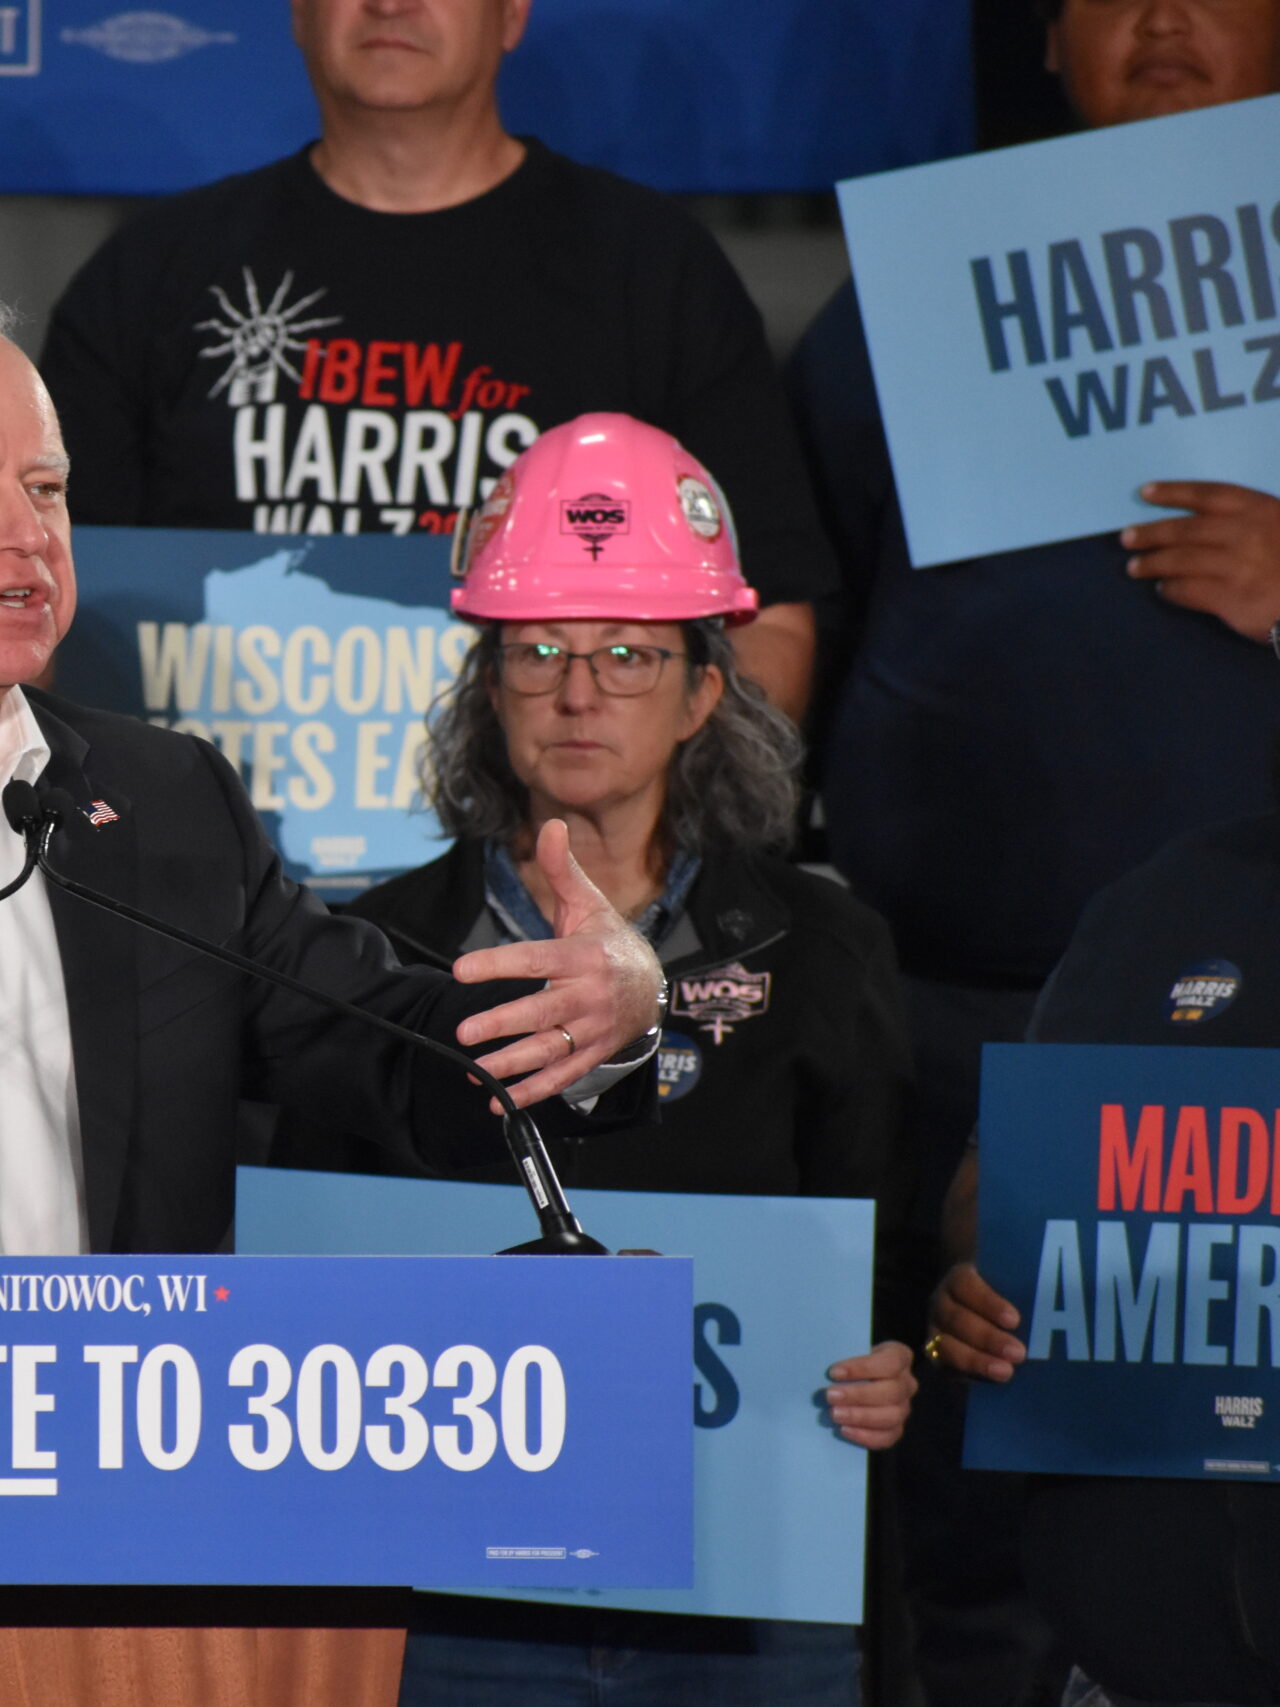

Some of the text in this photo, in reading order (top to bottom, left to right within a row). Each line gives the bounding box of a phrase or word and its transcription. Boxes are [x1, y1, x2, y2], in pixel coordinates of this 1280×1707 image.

[969, 200, 1280, 374] HARRI
[298, 338, 532, 421] IBEW for
[234, 403, 540, 507] HARRIS
[566, 508, 625, 524] WOS
[681, 980, 763, 1003] WOS
[1170, 979, 1237, 999] HARRIS
[1097, 1104, 1280, 1216] MAD
[157, 1274, 209, 1313] WI
[83, 1343, 202, 1472] TO
[228, 1343, 567, 1473] 30330
[1215, 1395, 1264, 1417] HARRIS
[1221, 1415, 1255, 1429] WALZ
